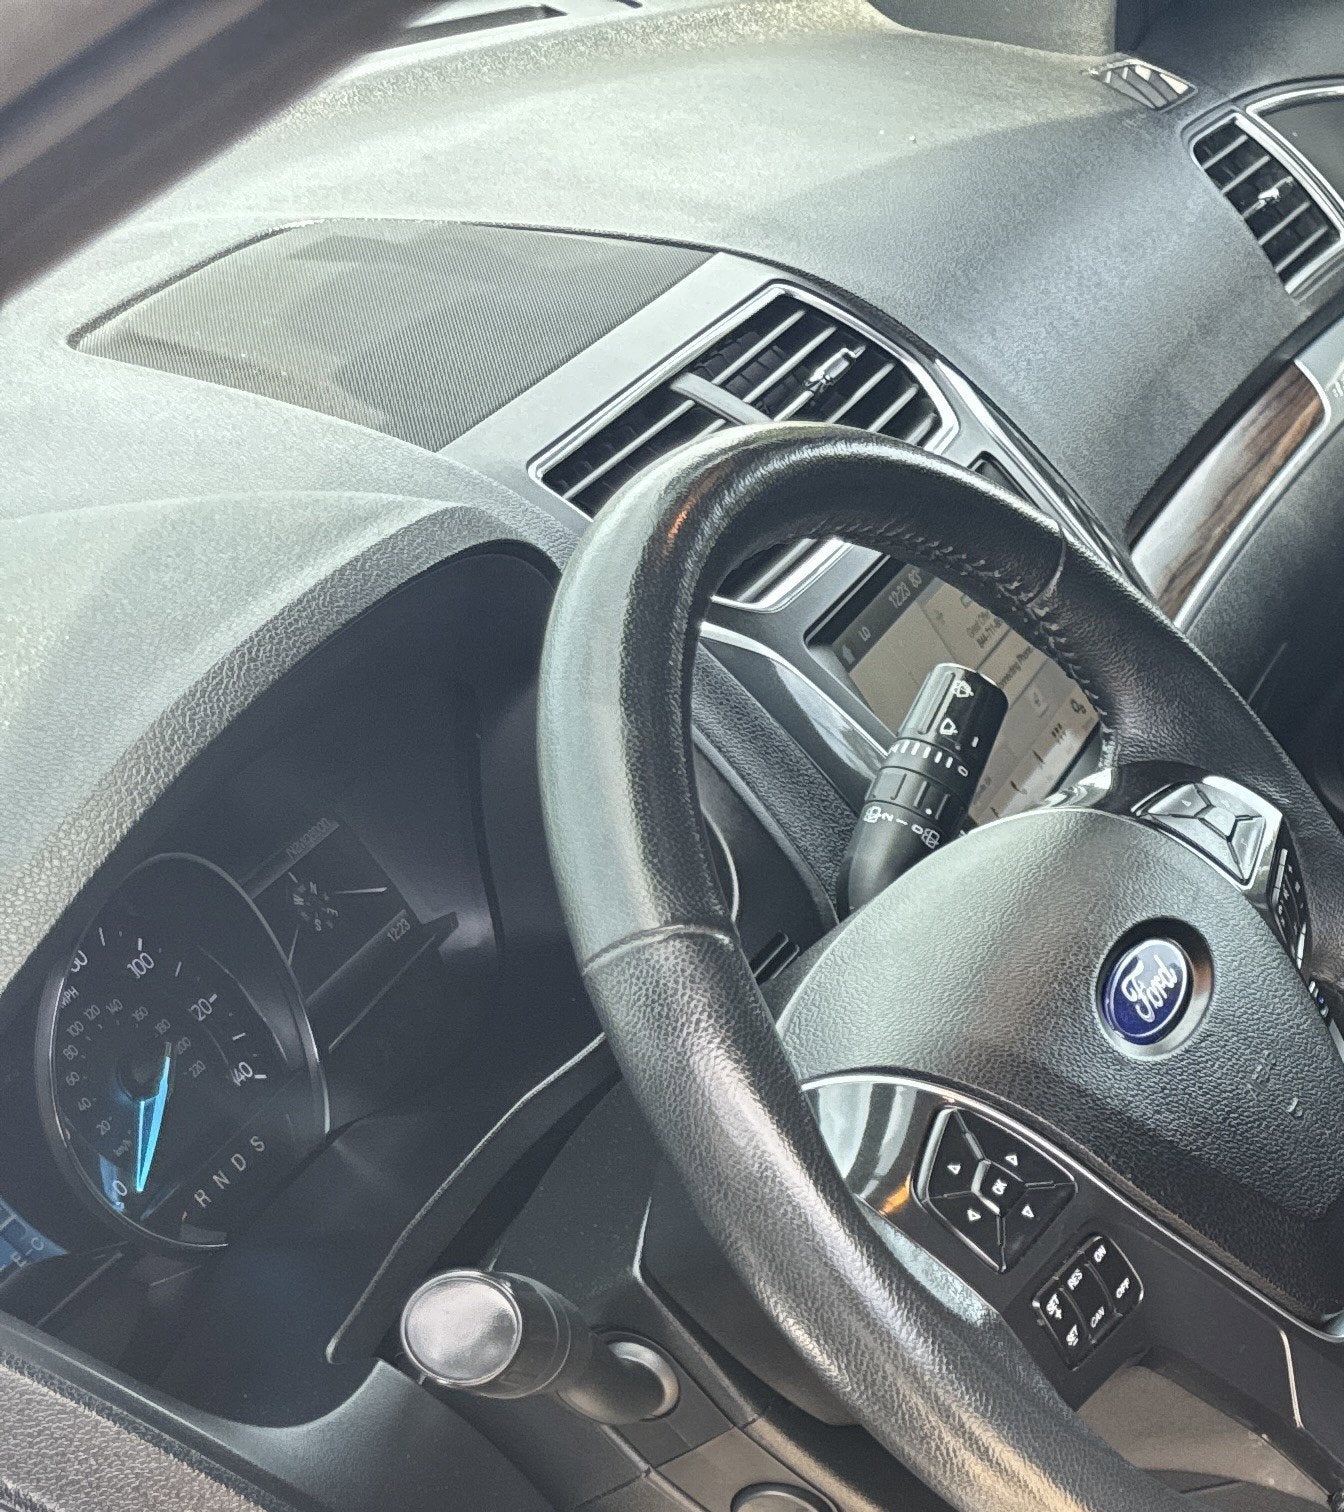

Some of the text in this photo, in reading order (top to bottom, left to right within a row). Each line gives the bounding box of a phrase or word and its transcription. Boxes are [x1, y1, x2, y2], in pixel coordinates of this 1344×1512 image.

[126, 951, 156, 980] 100
[1121, 954, 1178, 1023] Ford
[65, 1019, 85, 1038] 100
[194, 1135, 267, 1209] R N D S
[991, 1178, 1008, 1196] OK
[1093, 1244, 1107, 1263] ON
[1067, 1267, 1083, 1291] RES
[1115, 1277, 1130, 1299] OFF
[1089, 1306, 1106, 1329] CAN
